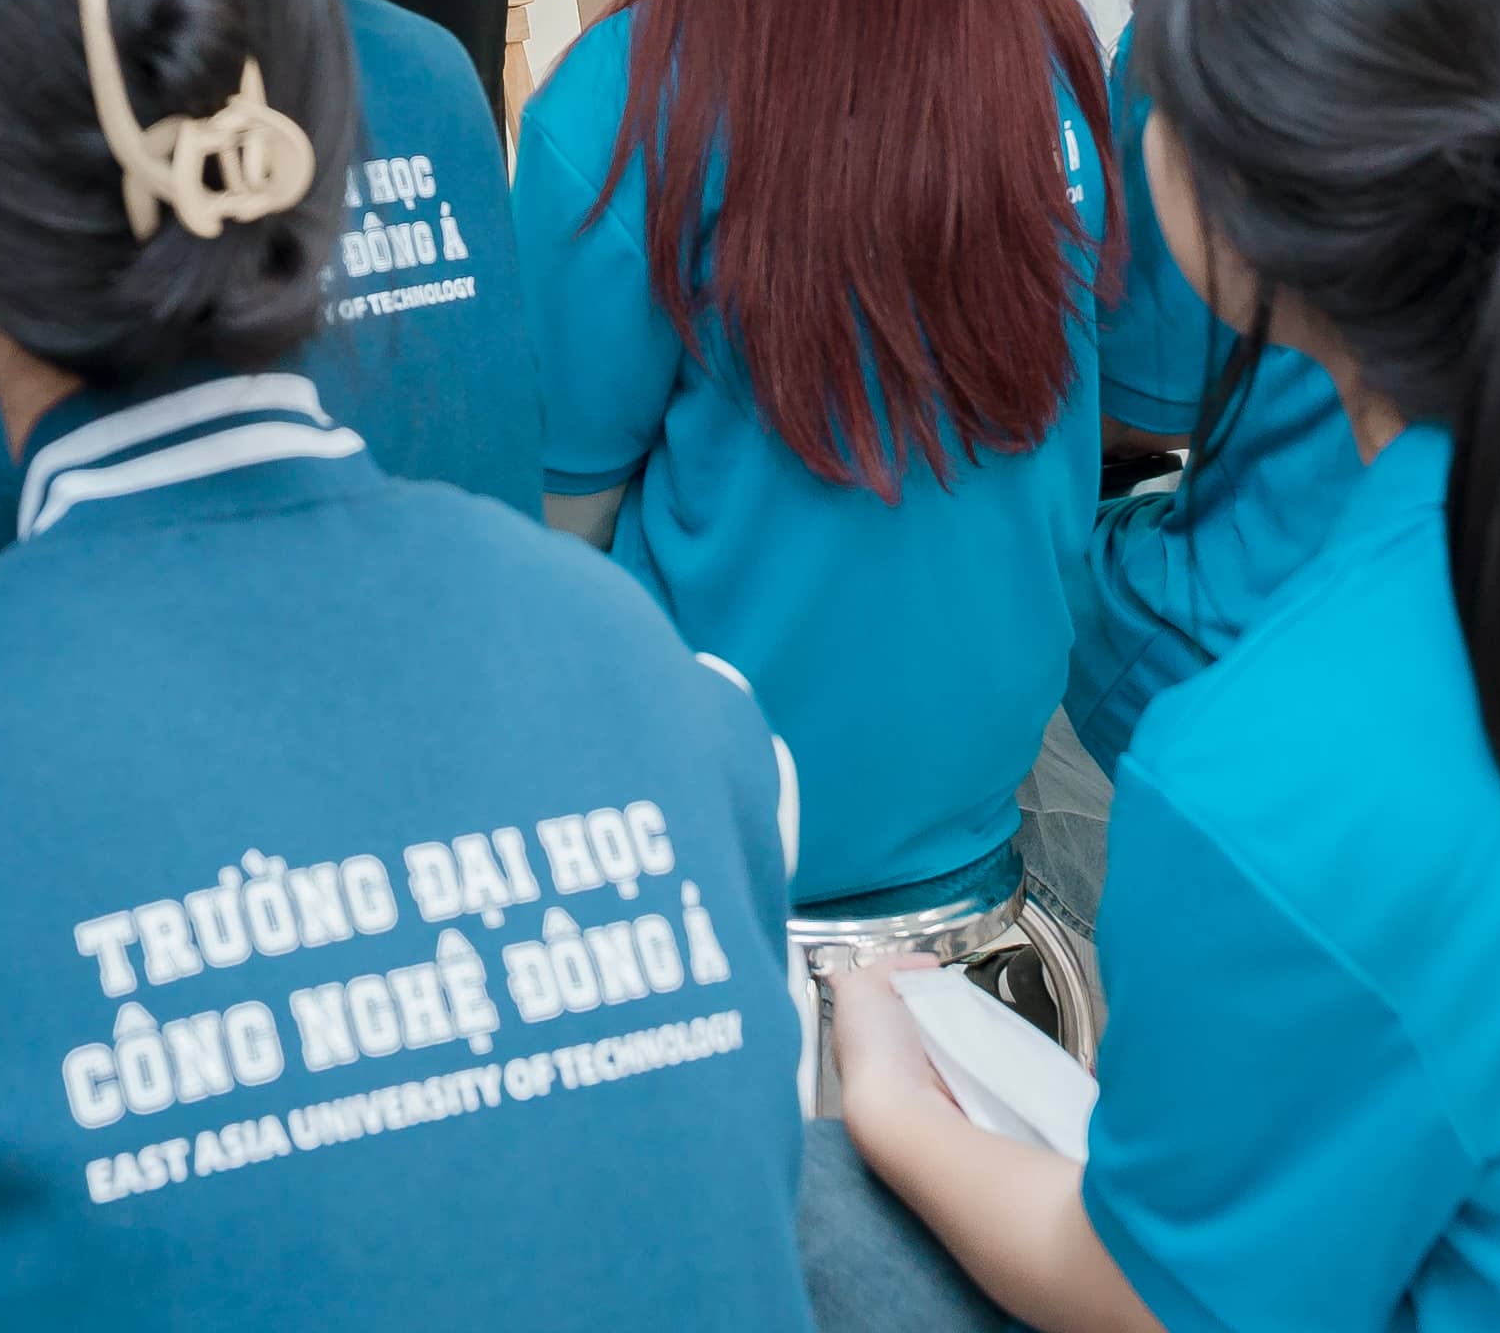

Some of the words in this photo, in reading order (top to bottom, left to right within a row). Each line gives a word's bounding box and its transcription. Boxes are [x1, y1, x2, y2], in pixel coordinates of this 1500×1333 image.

[340, 211, 437, 278] ĐÔNG
[440, 201, 470, 261] Á
[363, 155, 437, 211] HỌC
[338, 297, 368, 321] OF
[367, 276, 476, 316] TECHNOLOGY
[74, 847, 399, 999] TRƯỜNG
[403, 826, 541, 930] ĐẠI
[536, 799, 675, 900] HỌC
[62, 1001, 285, 1130] CÔNG
[289, 928, 501, 1073] NGHỆ
[502, 907, 685, 1024] ĐÔNG
[682, 879, 732, 986] Á
[86, 1137, 190, 1205] EAST
[194, 1115, 292, 1178] ASIA
[288, 1063, 502, 1151] UNIVERSITY
[504, 1054, 556, 1102] OF
[554, 1010, 744, 1090] TECHNOLOGY
